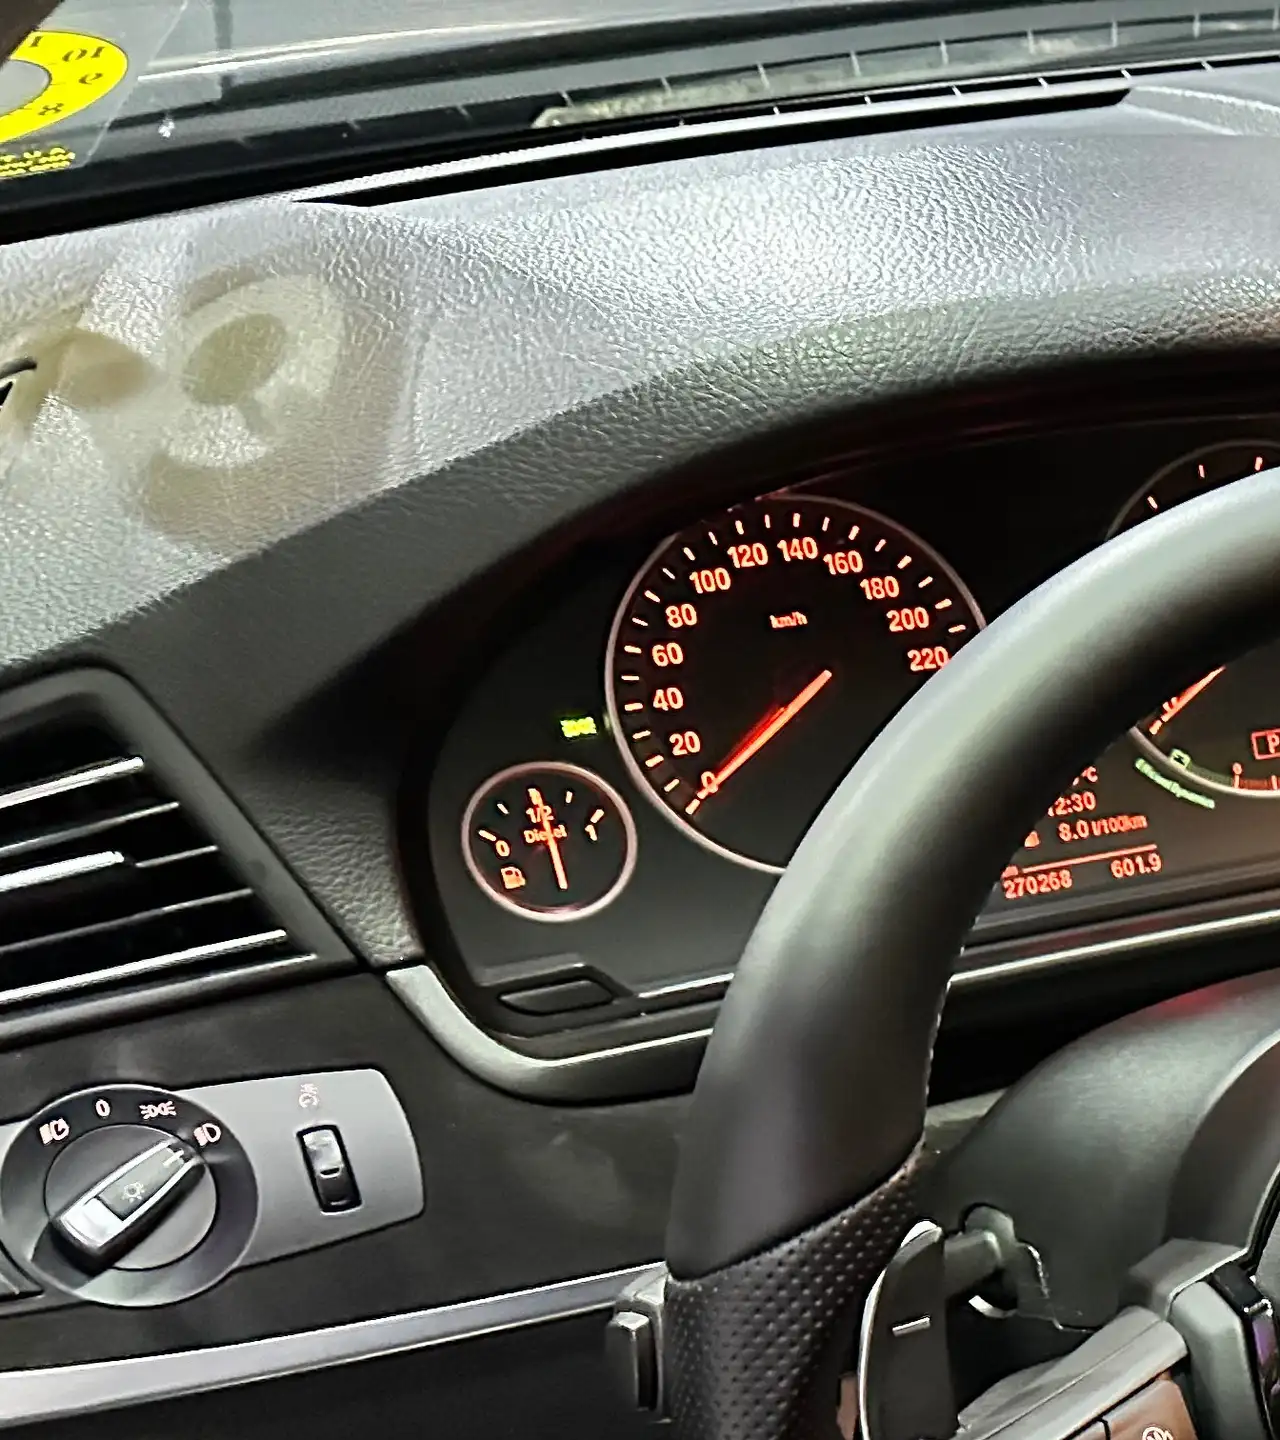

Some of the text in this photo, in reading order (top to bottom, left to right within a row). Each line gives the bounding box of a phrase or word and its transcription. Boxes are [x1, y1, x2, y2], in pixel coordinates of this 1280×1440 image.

[727, 542, 768, 569] 120
[777, 536, 818, 561] 140
[823, 550, 863, 575] 160
[689, 567, 731, 594] 100
[860, 575, 899, 600] 180
[665, 603, 697, 628] 80
[769, 611, 808, 628] km/h
[886, 607, 929, 632] 200
[651, 642, 683, 667] 60
[907, 646, 950, 672] 220
[652, 687, 684, 711] 40
[668, 730, 700, 756] 20
[1266, 731, 1280, 753] P
[700, 771, 720, 793] 0
[526, 804, 555, 824] 1/2
[584, 824, 598, 842] 1
[495, 839, 511, 857] 0
[1003, 852, 1163, 899] 270268 601.9
